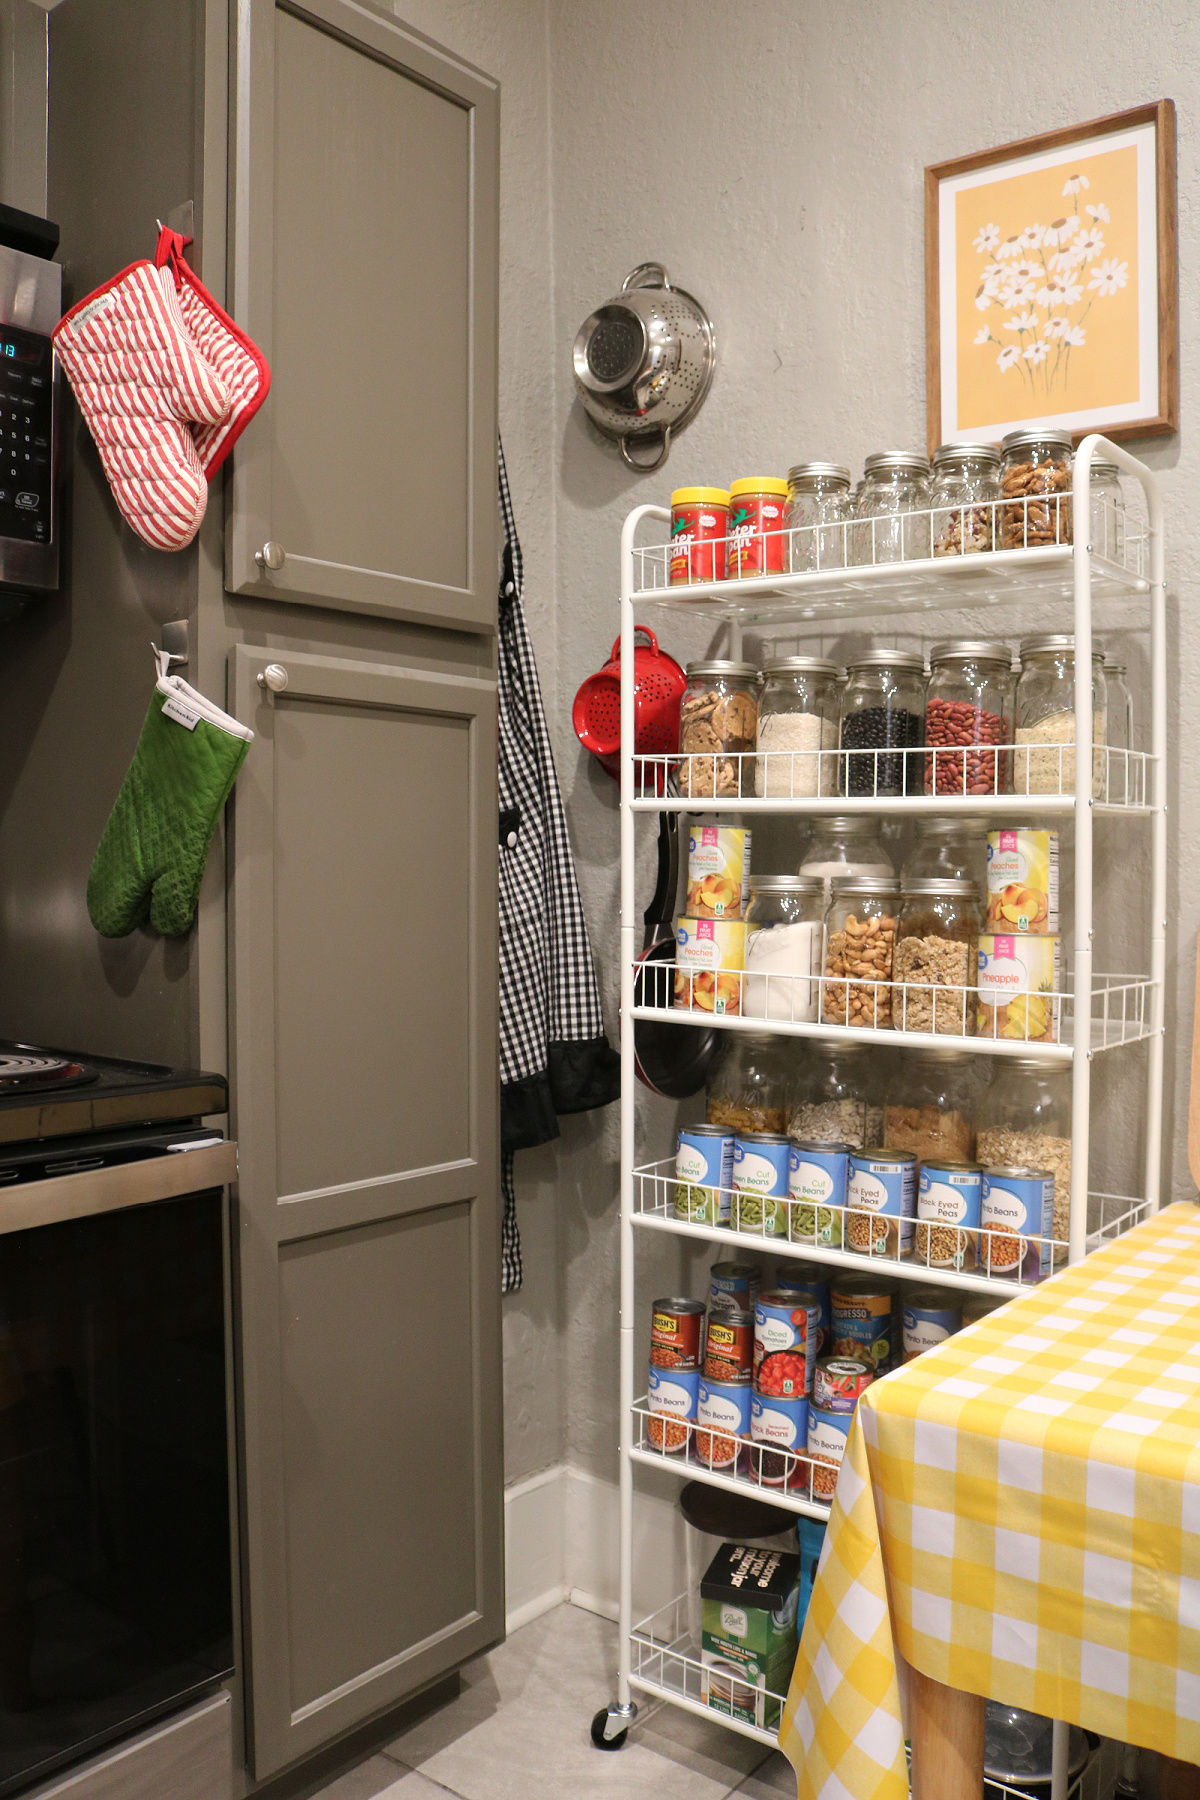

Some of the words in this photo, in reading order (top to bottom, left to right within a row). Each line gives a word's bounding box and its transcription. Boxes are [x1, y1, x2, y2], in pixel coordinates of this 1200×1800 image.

[11, 413, 17, 421] 2
[24, 416, 30, 424] 3
[11, 450, 17, 458] 8
[24, 453, 30, 461] 9
[10, 468, 17, 476] 0
[730, 524, 757, 540] eter
[167, 703, 194, 722] KitchenAid
[693, 854, 718, 862] Peaches
[684, 947, 713, 957] Peaches
[982, 972, 1020, 985] Pineapple
[688, 1160, 701, 1169] Cut
[681, 1166, 700, 1176] Beans
[756, 1170, 770, 1178] Cut
[747, 1176, 770, 1186] Beans
[811, 1179, 826, 1188] Cut
[802, 1185, 825, 1196] Beans
[860, 1188, 880, 1199] Eyed
[860, 1197, 879, 1206] Peas
[938, 1200, 959, 1211] Eyed
[937, 1208, 958, 1218] Peas
[993, 1206, 1019, 1218] Beans
[653, 1316, 675, 1330] BUSH'S
[652, 1329, 677, 1341] Original
[710, 1326, 731, 1341] BUSH'S
[761, 1334, 787, 1344] Tomatoes
[768, 1329, 787, 1338] Diced
[708, 1339, 733, 1353] Original
[663, 1396, 685, 1406] Beans
[712, 1410, 734, 1421] Beans
[765, 1428, 789, 1438] Beans
[820, 1440, 844, 1451] Beans
[758, 1550, 772, 1560] to
[736, 1548, 758, 1576] mason
[749, 1556, 768, 1577] your
[757, 1552, 782, 1588] welcome
[730, 1572, 749, 1588] jar
[724, 1613, 745, 1627] Ball
